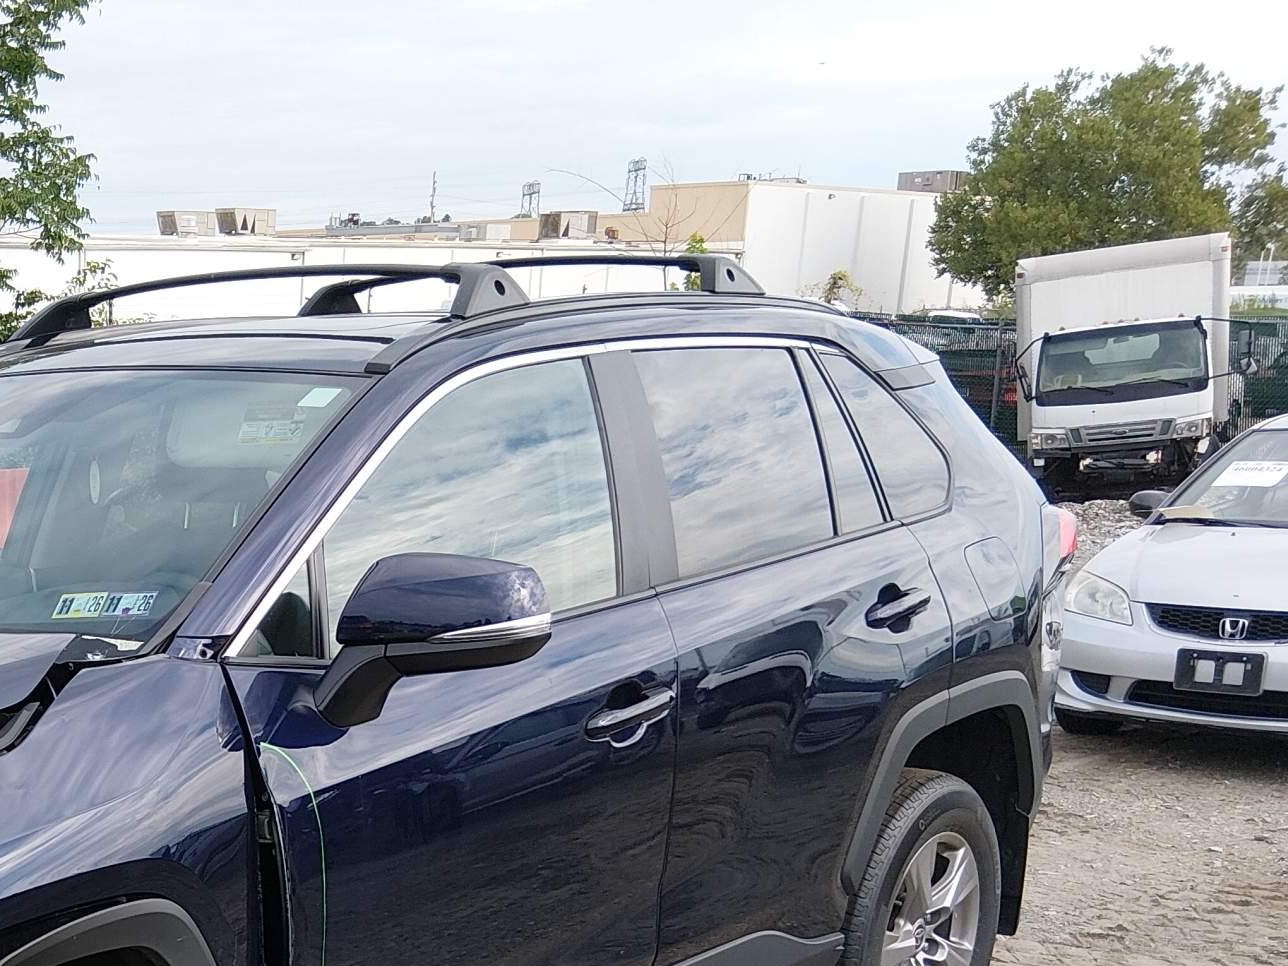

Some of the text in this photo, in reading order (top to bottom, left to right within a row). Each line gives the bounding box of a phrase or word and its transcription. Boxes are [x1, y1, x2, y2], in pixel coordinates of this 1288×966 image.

[57, 595, 104, 615] 11 26
[105, 594, 153, 613] 11 26
